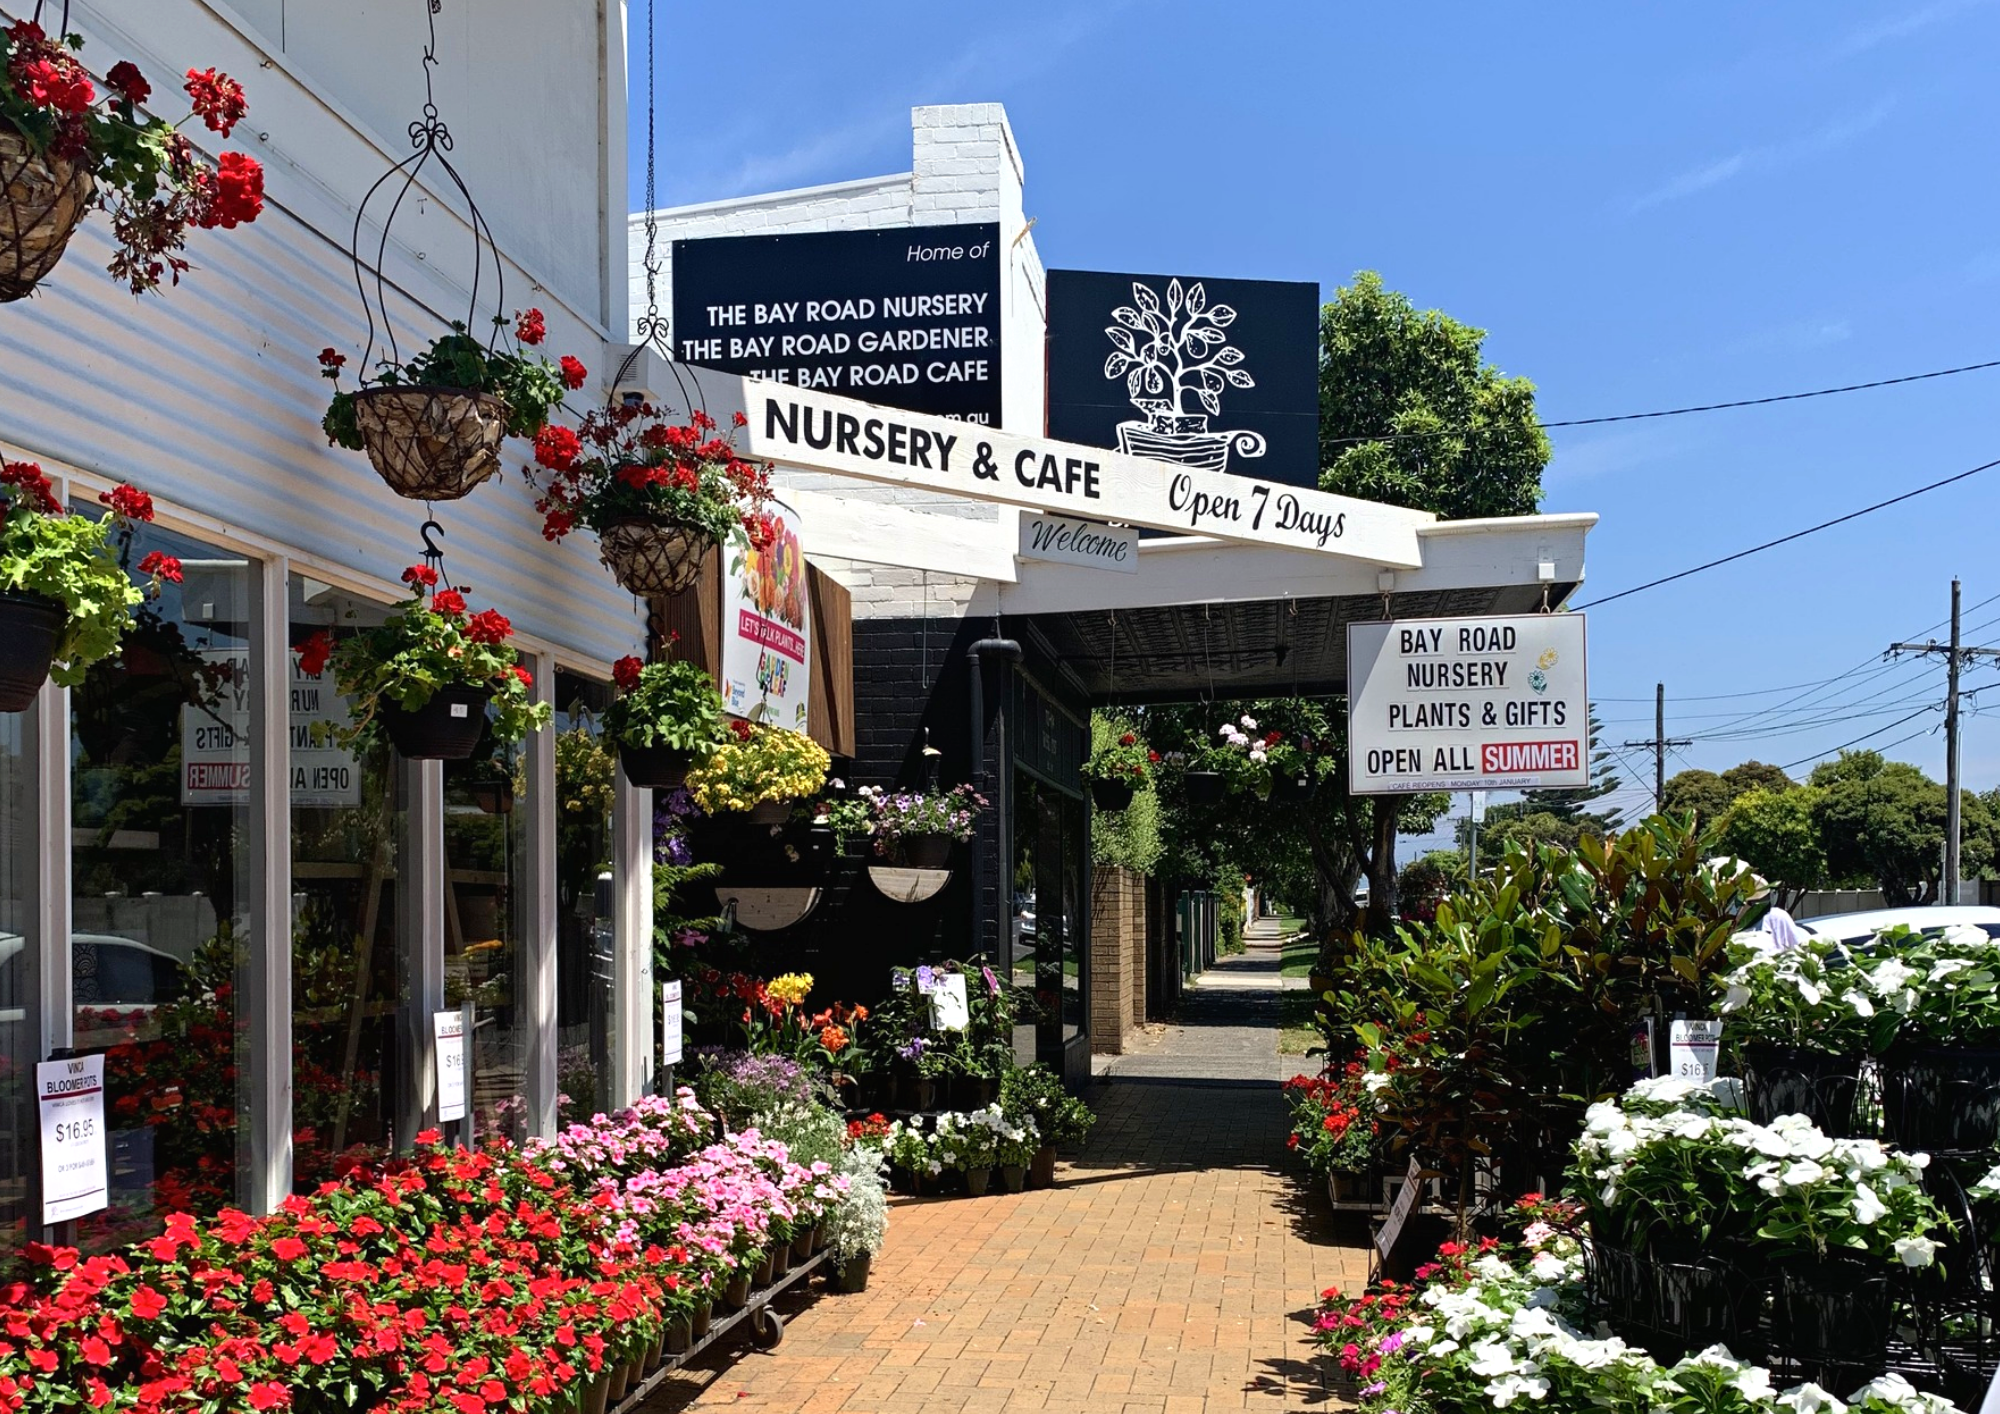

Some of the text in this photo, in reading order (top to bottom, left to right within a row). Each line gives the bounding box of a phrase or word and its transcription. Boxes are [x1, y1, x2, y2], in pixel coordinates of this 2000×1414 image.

[907, 241, 990, 262] Home of
[707, 292, 989, 327] THE BAY ROAD NURSERY
[682, 326, 989, 361] THE BAY ROAD GARDENER
[797, 366, 843, 388] BAY
[850, 363, 919, 386] ROAD
[927, 360, 989, 384] CAFE
[765, 398, 1347, 547] NURSERY & CAFE Open 7 Days
[1032, 520, 1129, 562] Welcome
[740, 616, 760, 636] LET'S
[1400, 626, 1516, 654] BAY ROAD
[1407, 661, 1508, 688] NURSERY
[1389, 700, 1567, 728] PLANTS & GIFTS
[1367, 743, 1576, 774] OPEN ALL SUMMER
[1412, 780, 1446, 789] REOPENS
[1450, 779, 1480, 787] MONDAY
[1484, 778, 1498, 787] 10th
[1499, 777, 1531, 786] JANUARY
[67, 1062, 84, 1074] VINCA
[56, 1118, 94, 1143] $16.95
